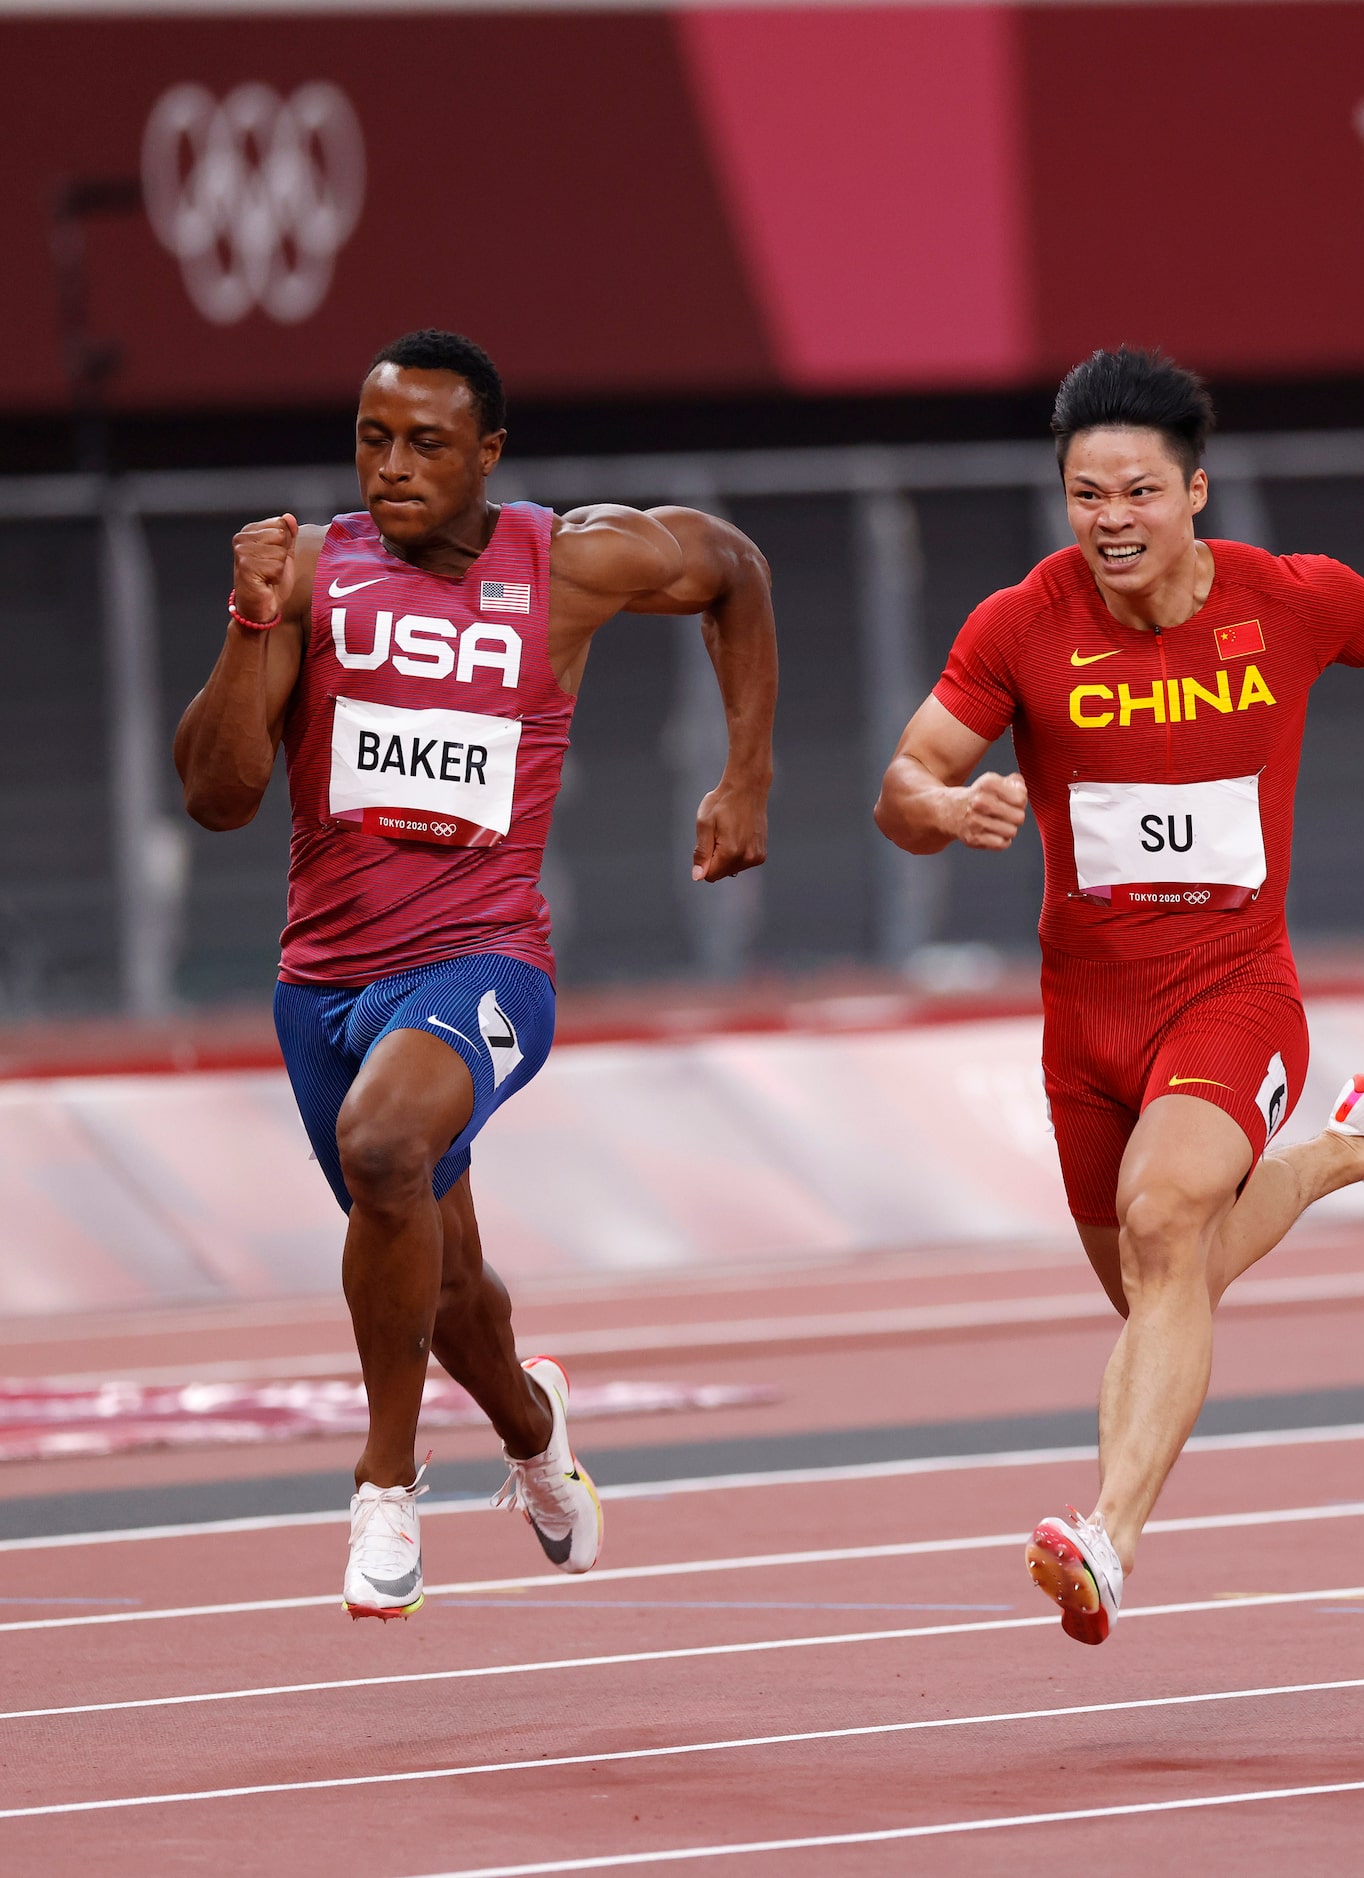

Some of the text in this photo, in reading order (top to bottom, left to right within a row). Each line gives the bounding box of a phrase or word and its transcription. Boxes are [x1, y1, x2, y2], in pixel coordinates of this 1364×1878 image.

[330, 607, 523, 688] USA
[1069, 664, 1277, 728] CHINA
[357, 730, 488, 785] BAKER
[378, 816, 428, 831] TOKYO 2020
[1140, 814, 1194, 852] SU
[1129, 892, 1181, 903] TOKYO 2020
